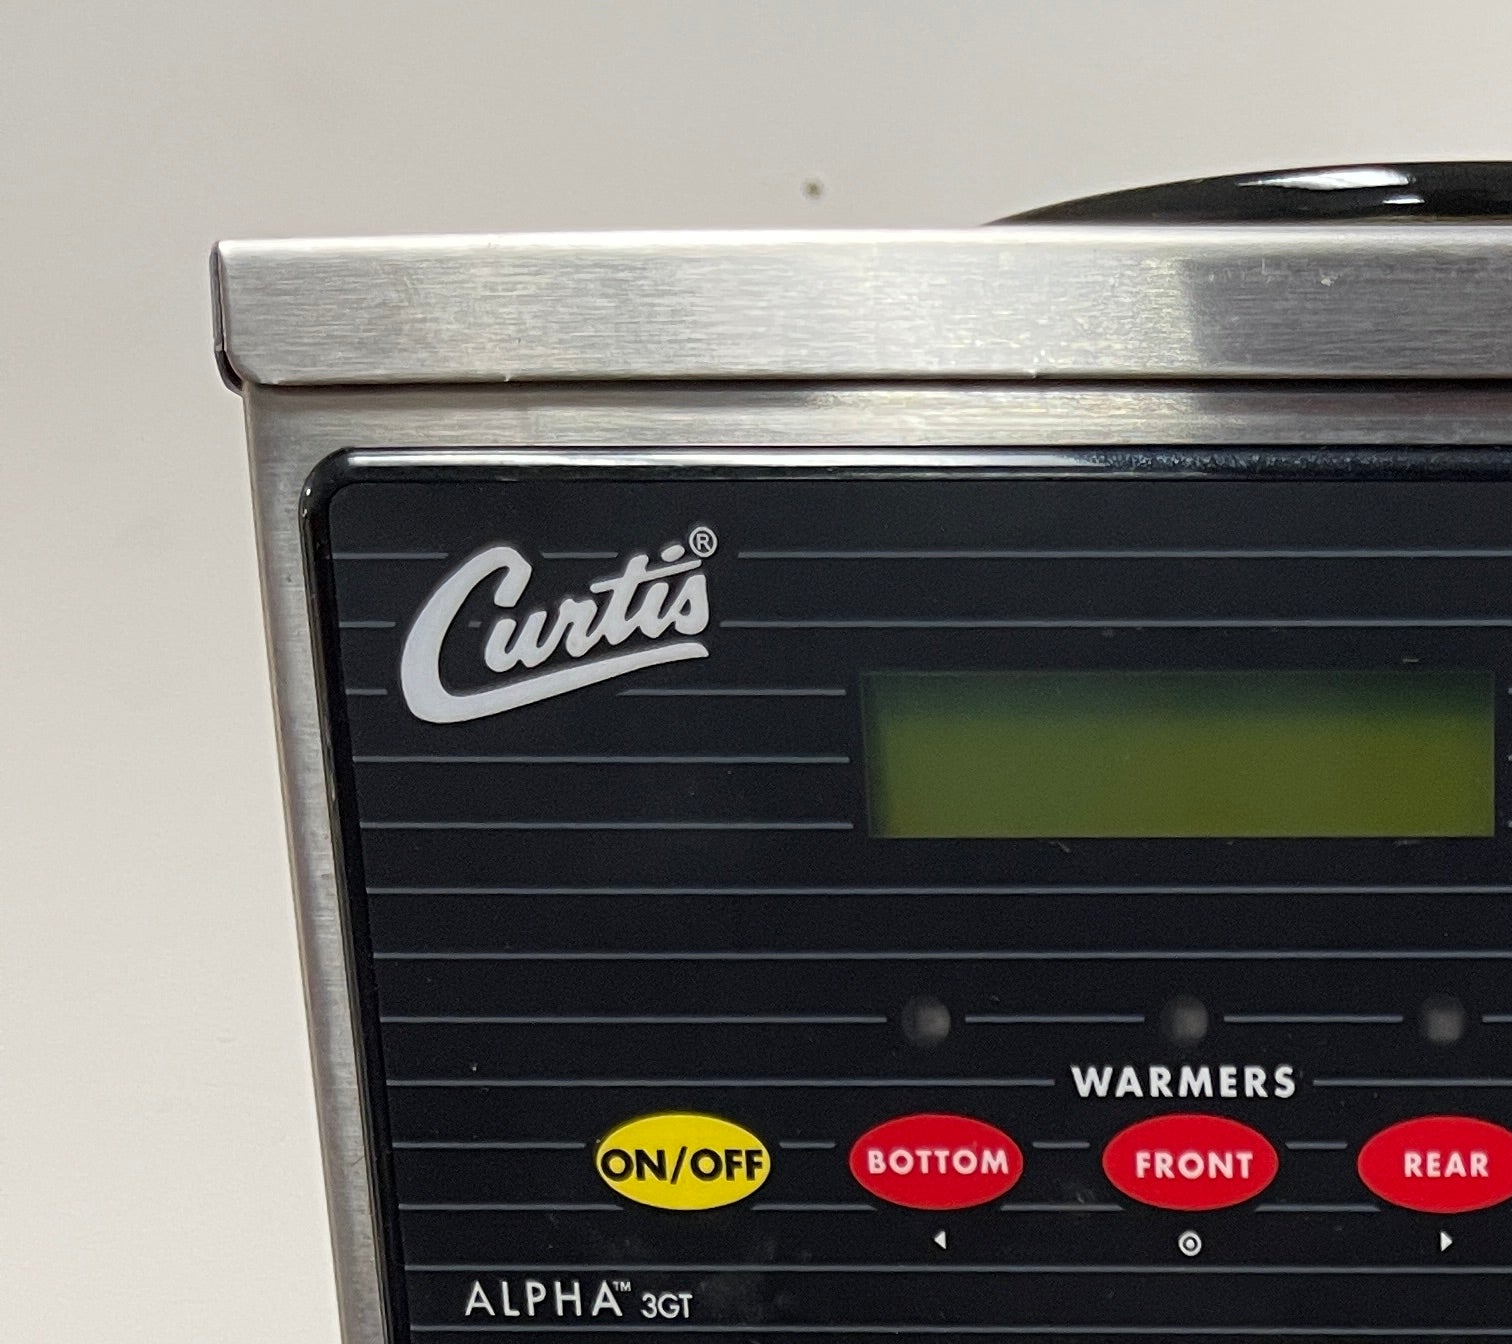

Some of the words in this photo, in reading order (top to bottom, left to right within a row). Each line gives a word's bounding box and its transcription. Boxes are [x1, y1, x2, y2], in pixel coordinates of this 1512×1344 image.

[1071, 1066, 1297, 1099] WARMERS
[601, 1148, 764, 1181] ON/OFF
[868, 1149, 1009, 1175] BOTTOM
[1135, 1151, 1254, 1179] FRONT
[1403, 1152, 1489, 1178] REAR
[641, 1294, 692, 1319] 3GT
